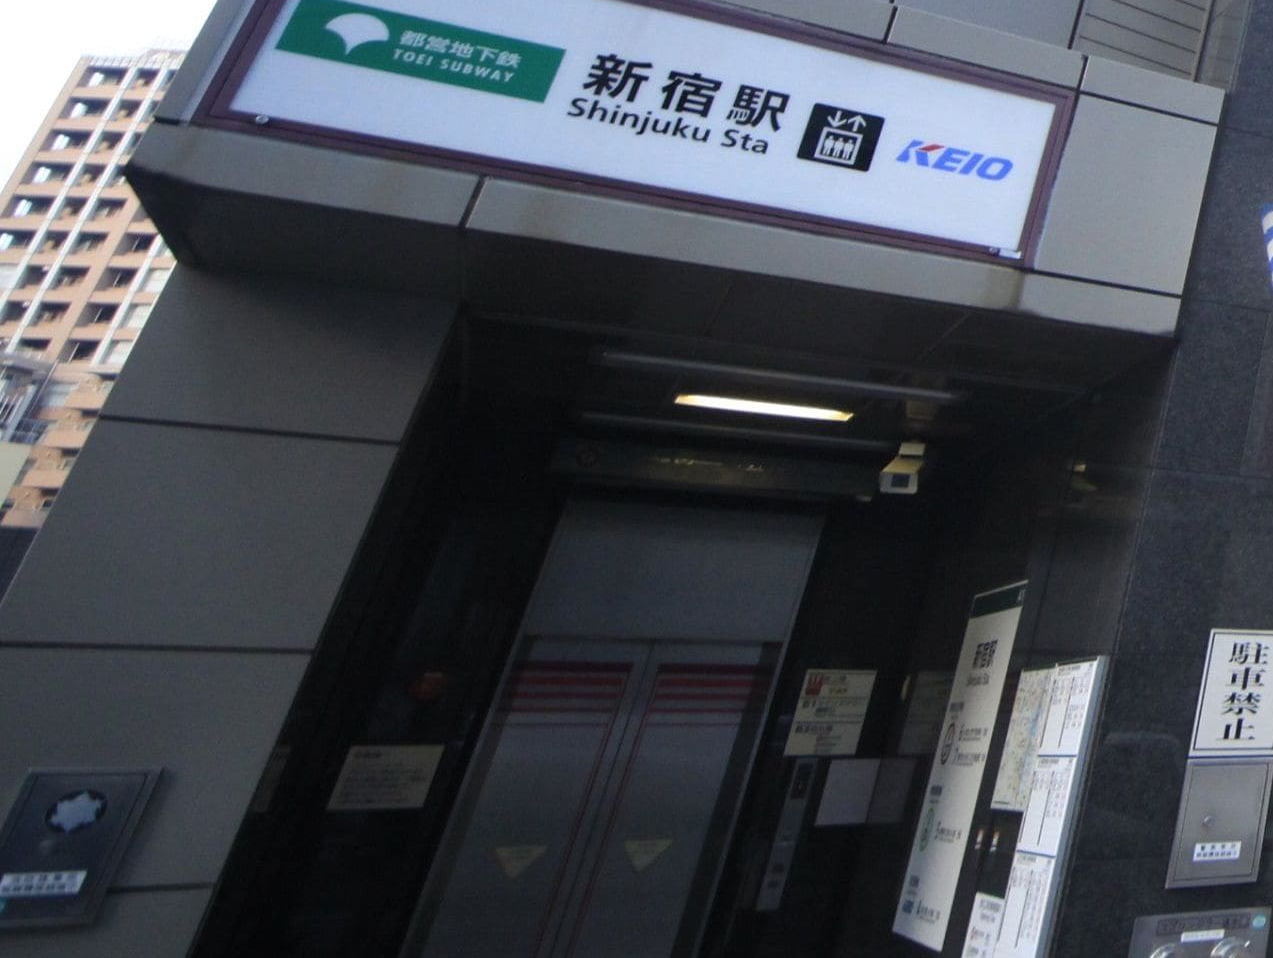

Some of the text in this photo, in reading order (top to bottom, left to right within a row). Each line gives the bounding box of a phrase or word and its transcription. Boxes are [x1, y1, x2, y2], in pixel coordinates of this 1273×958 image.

[393, 48, 515, 83] TOEI SUBWAY
[400, 30, 522, 69] 都営地下鉄
[582, 53, 791, 134] 新宿駅
[567, 97, 770, 155] Shinjuku Sta
[895, 138, 1014, 182] KEIO
[1221, 640, 1271, 742] 駐車禁止
